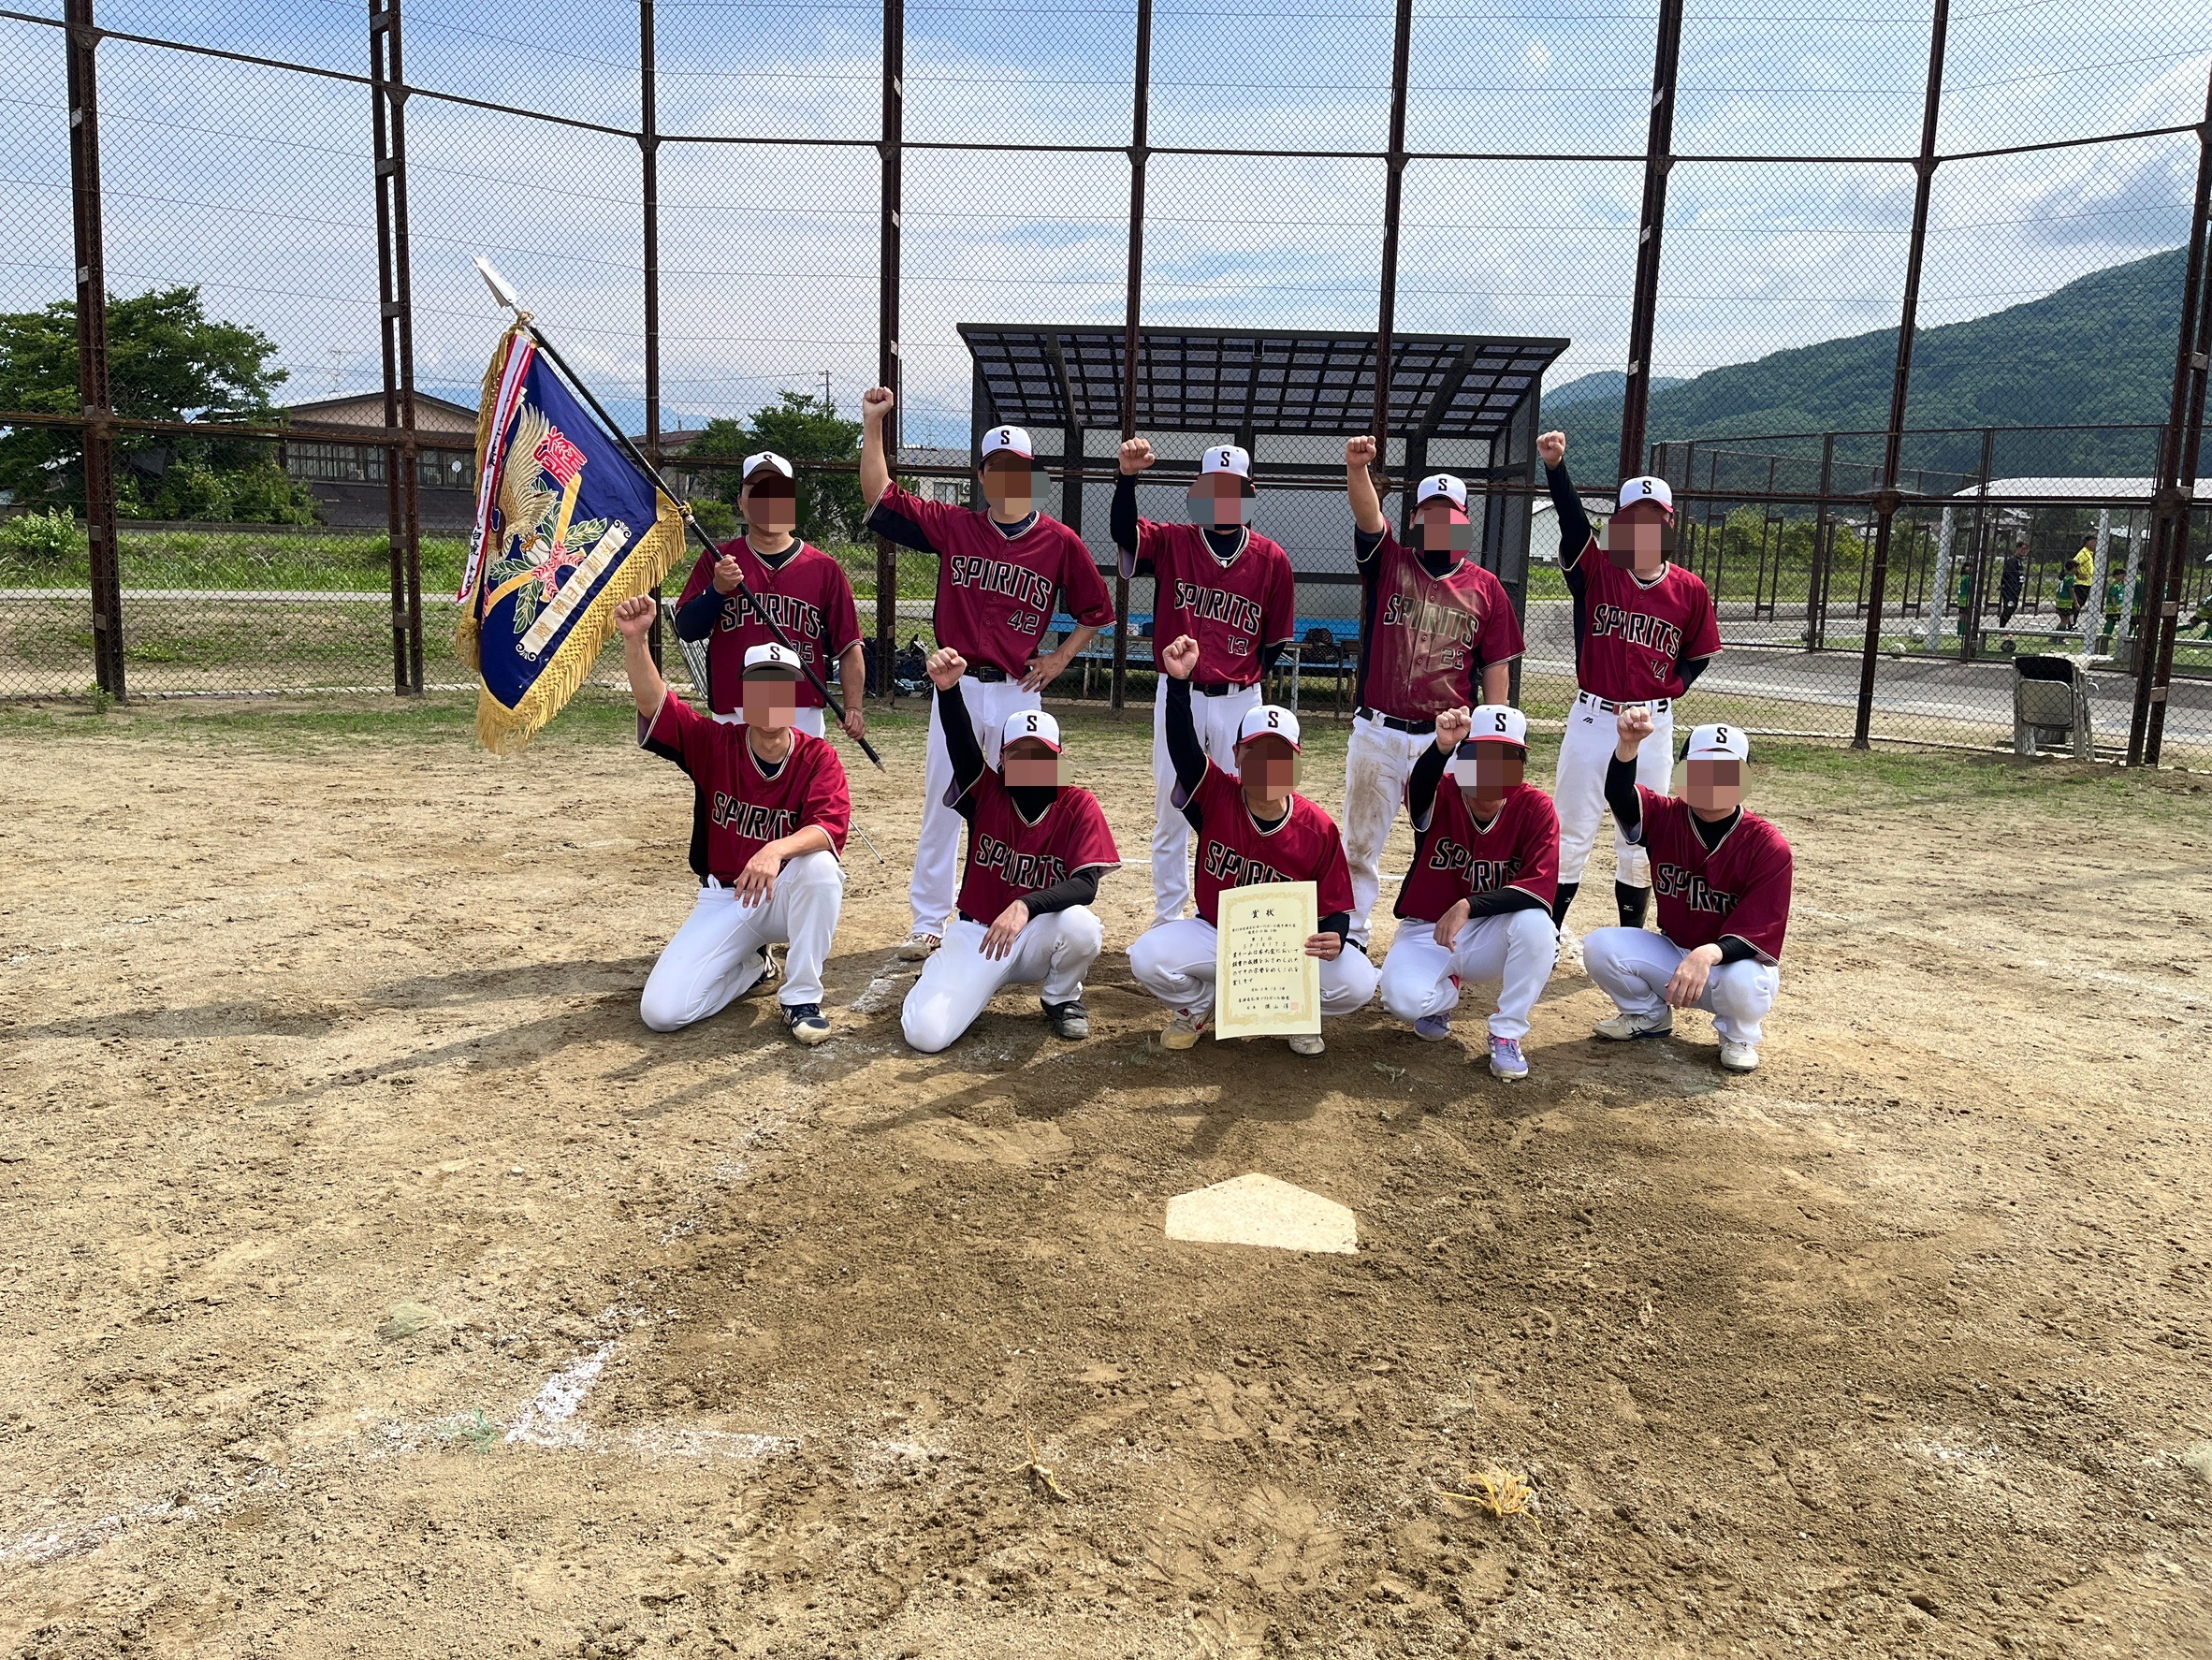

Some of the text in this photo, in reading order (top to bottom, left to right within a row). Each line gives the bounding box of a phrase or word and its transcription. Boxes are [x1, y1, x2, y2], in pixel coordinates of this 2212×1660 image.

[1000, 430, 1010, 445] S
[1220, 451, 1230, 467] S
[1438, 478, 1448, 491] S
[1642, 480, 1652, 495] S
[551, 541, 617, 618] 朝日新聞社
[951, 555, 1053, 612] SPIRITS
[720, 592, 821, 640] SPIRITS
[1174, 578, 1261, 635] SPIRITS
[1008, 609, 1040, 634] 42
[1383, 593, 1479, 649] SPIRITS
[1592, 604, 1682, 660] SPIRITS
[770, 646, 780, 662] S
[1228, 634, 1249, 656] 13
[1440, 647, 1466, 670] 23
[1651, 659, 1668, 682] 14
[1027, 715, 1038, 732] S
[1268, 710, 1279, 728] S
[1495, 713, 1506, 732] S
[1716, 727, 1728, 744] S
[975, 833, 1067, 889] SPIRITS
